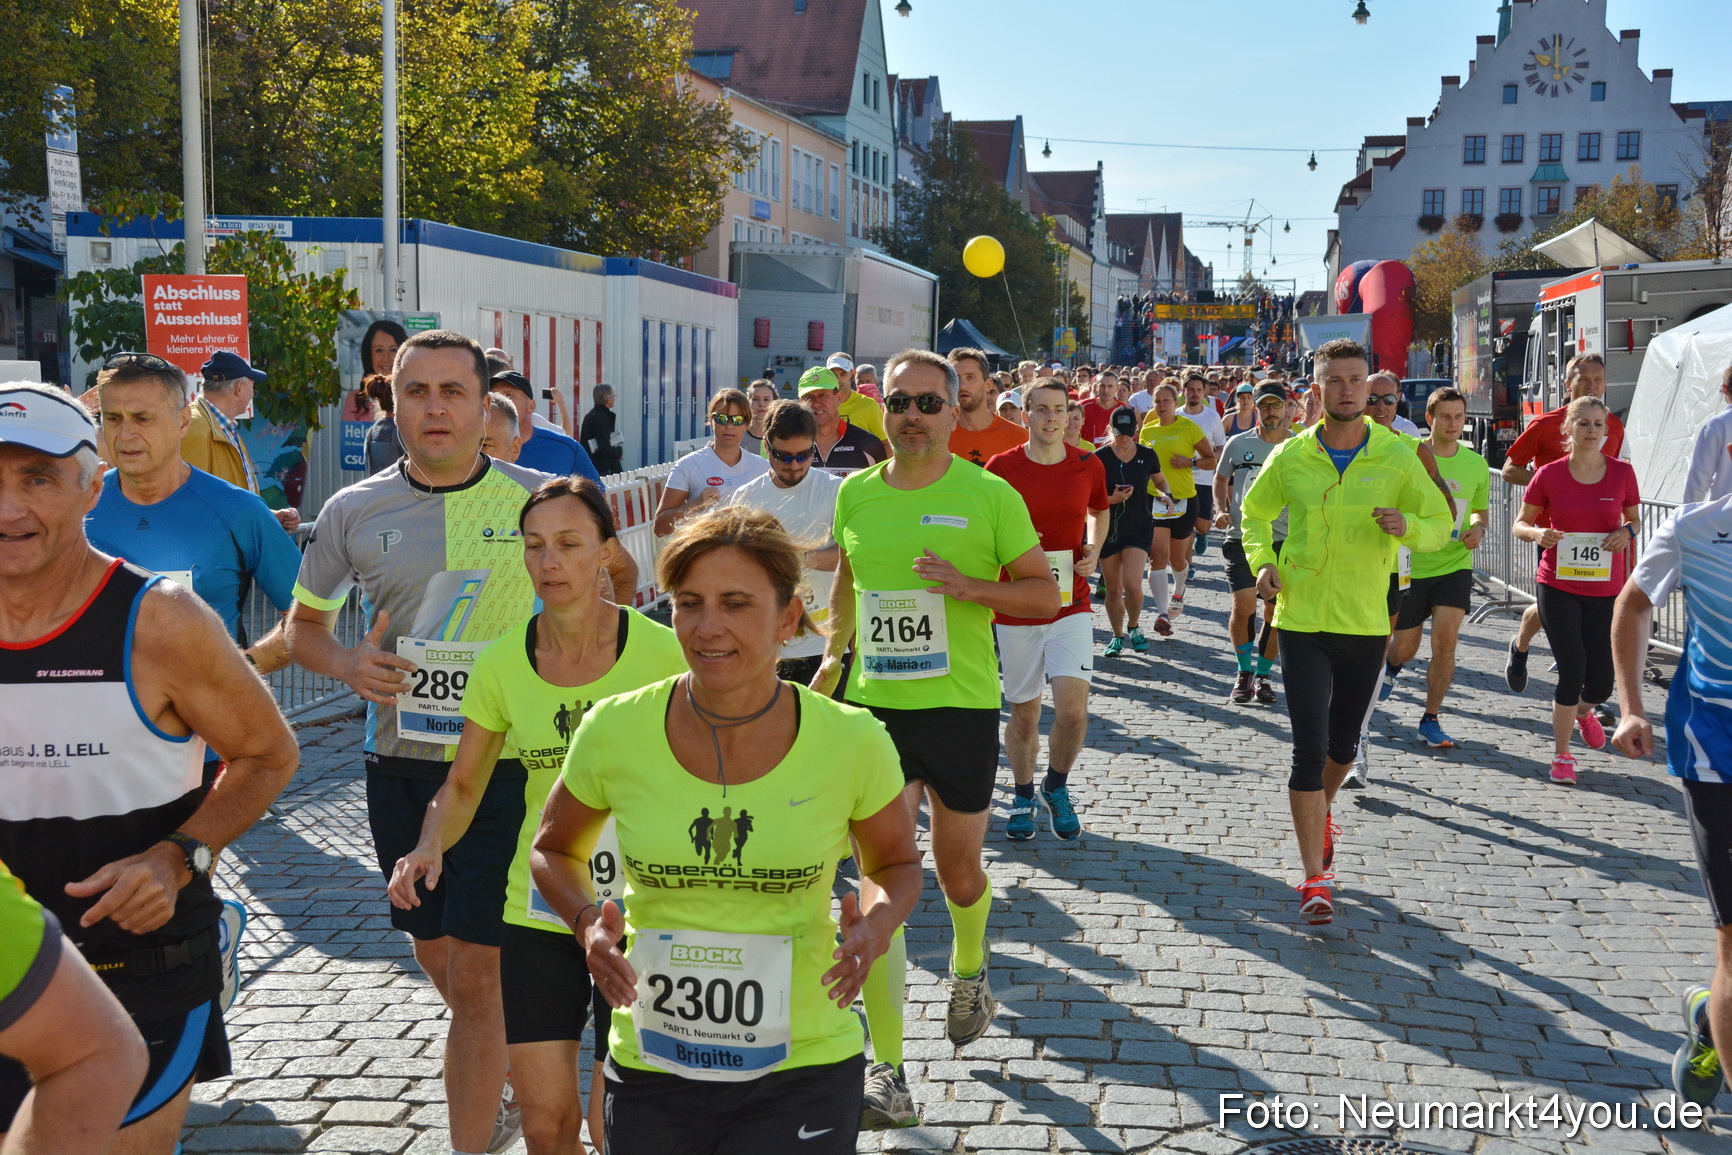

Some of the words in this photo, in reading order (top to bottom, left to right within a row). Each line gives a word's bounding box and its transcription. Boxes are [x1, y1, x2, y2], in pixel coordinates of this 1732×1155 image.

[54, 158, 63, 166] nur
[65, 160, 74, 168] mit
[51, 165, 78, 179] Parkschein
[54, 178, 77, 191] werktags
[153, 284, 241, 300] Abschluss
[153, 301, 183, 311] statt
[1187, 305, 1222, 317] START
[154, 312, 242, 326] Ausschluss!
[170, 334, 195, 343] Mehr
[197, 334, 226, 343] Lehrer
[227, 334, 240, 343] für
[166, 345, 204, 354] kleinere
[344, 454, 365, 465] CSU
[1571, 546, 1600, 561] 146
[879, 598, 918, 609] BOCK
[870, 615, 933, 643] 2164
[426, 649, 475, 661] BOCK
[36, 669, 48, 677] SV
[49, 669, 104, 677] ILLSCHWANG
[418, 703, 441, 711] PARTL
[27, 744, 39, 757] J.
[44, 744, 61, 757] B.
[66, 742, 110, 757] LELL
[11, 759, 34, 769] beginnt
[49, 760, 70, 768] LELL
[670, 944, 743, 965] BOCK
[648, 974, 764, 1027] 2300
[663, 1021, 692, 1037] PARTL
[694, 1029, 741, 1041] Neumarkt
[676, 1043, 744, 1068] Brigitte
